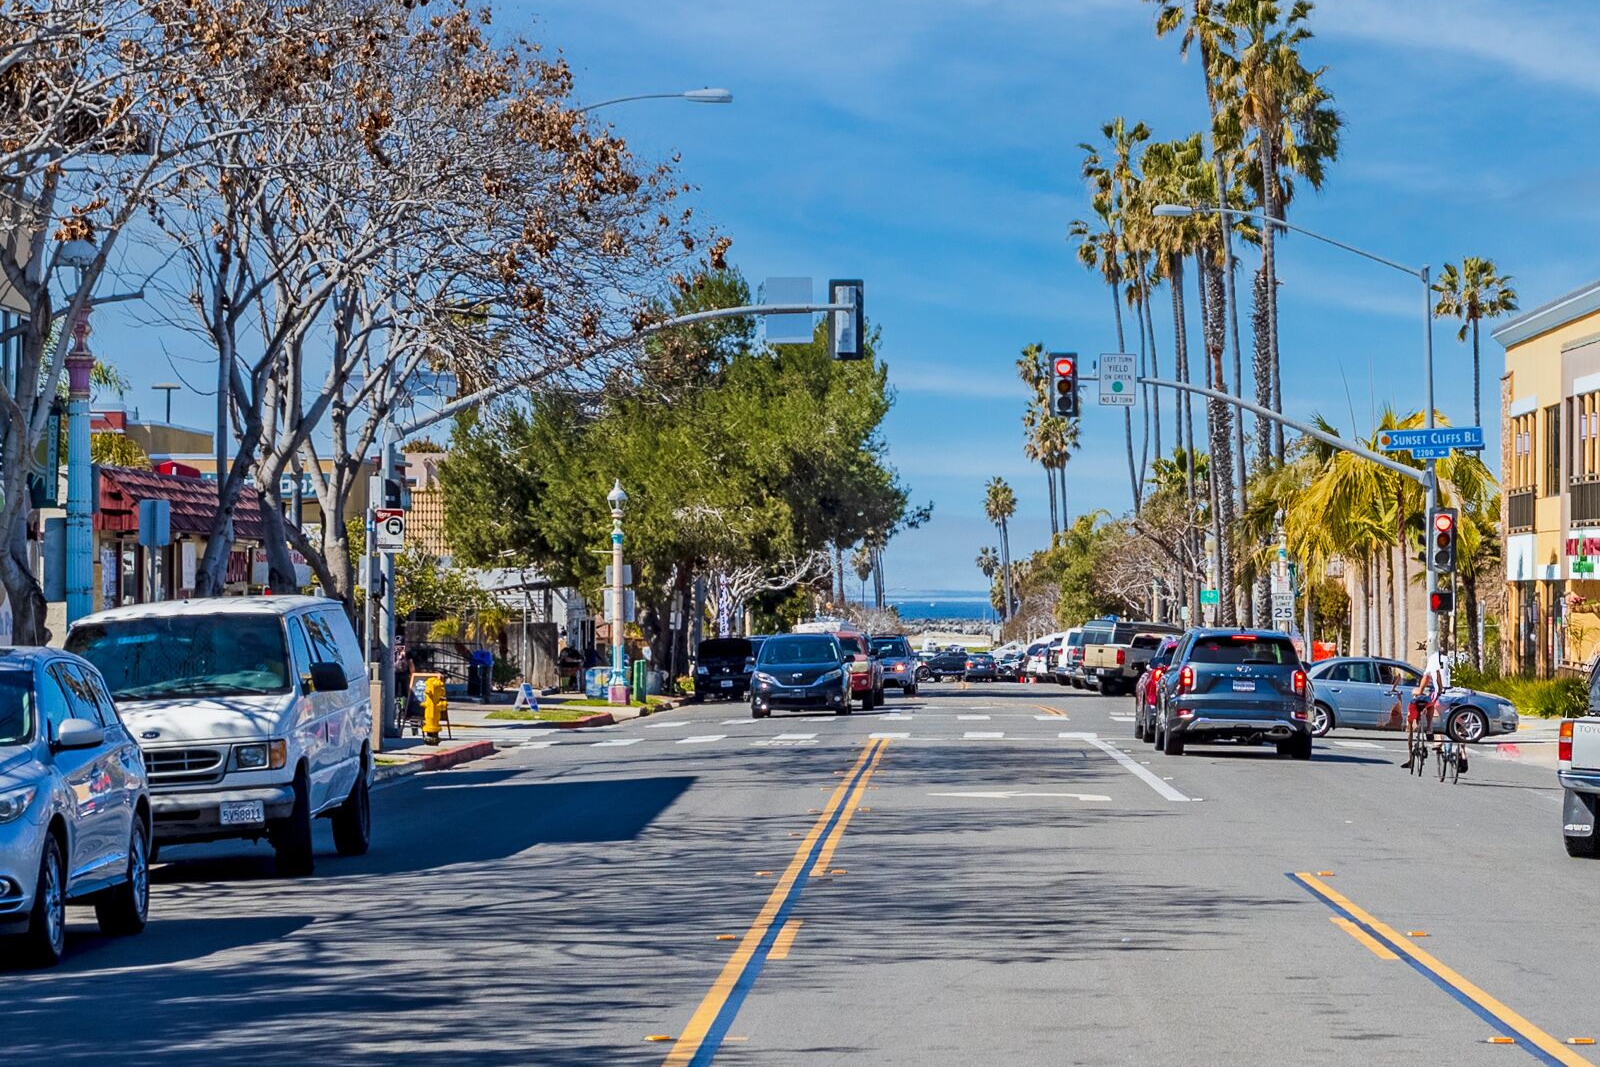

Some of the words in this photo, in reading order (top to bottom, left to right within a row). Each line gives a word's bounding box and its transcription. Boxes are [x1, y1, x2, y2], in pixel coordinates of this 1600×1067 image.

[1108, 364, 1129, 373] YIELD
[1392, 434, 1427, 446] SUNSET
[1430, 432, 1461, 444] CLIFFS
[1416, 449, 1434, 457] 2200
[1274, 607, 1293, 618] 25
[1564, 823, 1591, 832] 4WD
